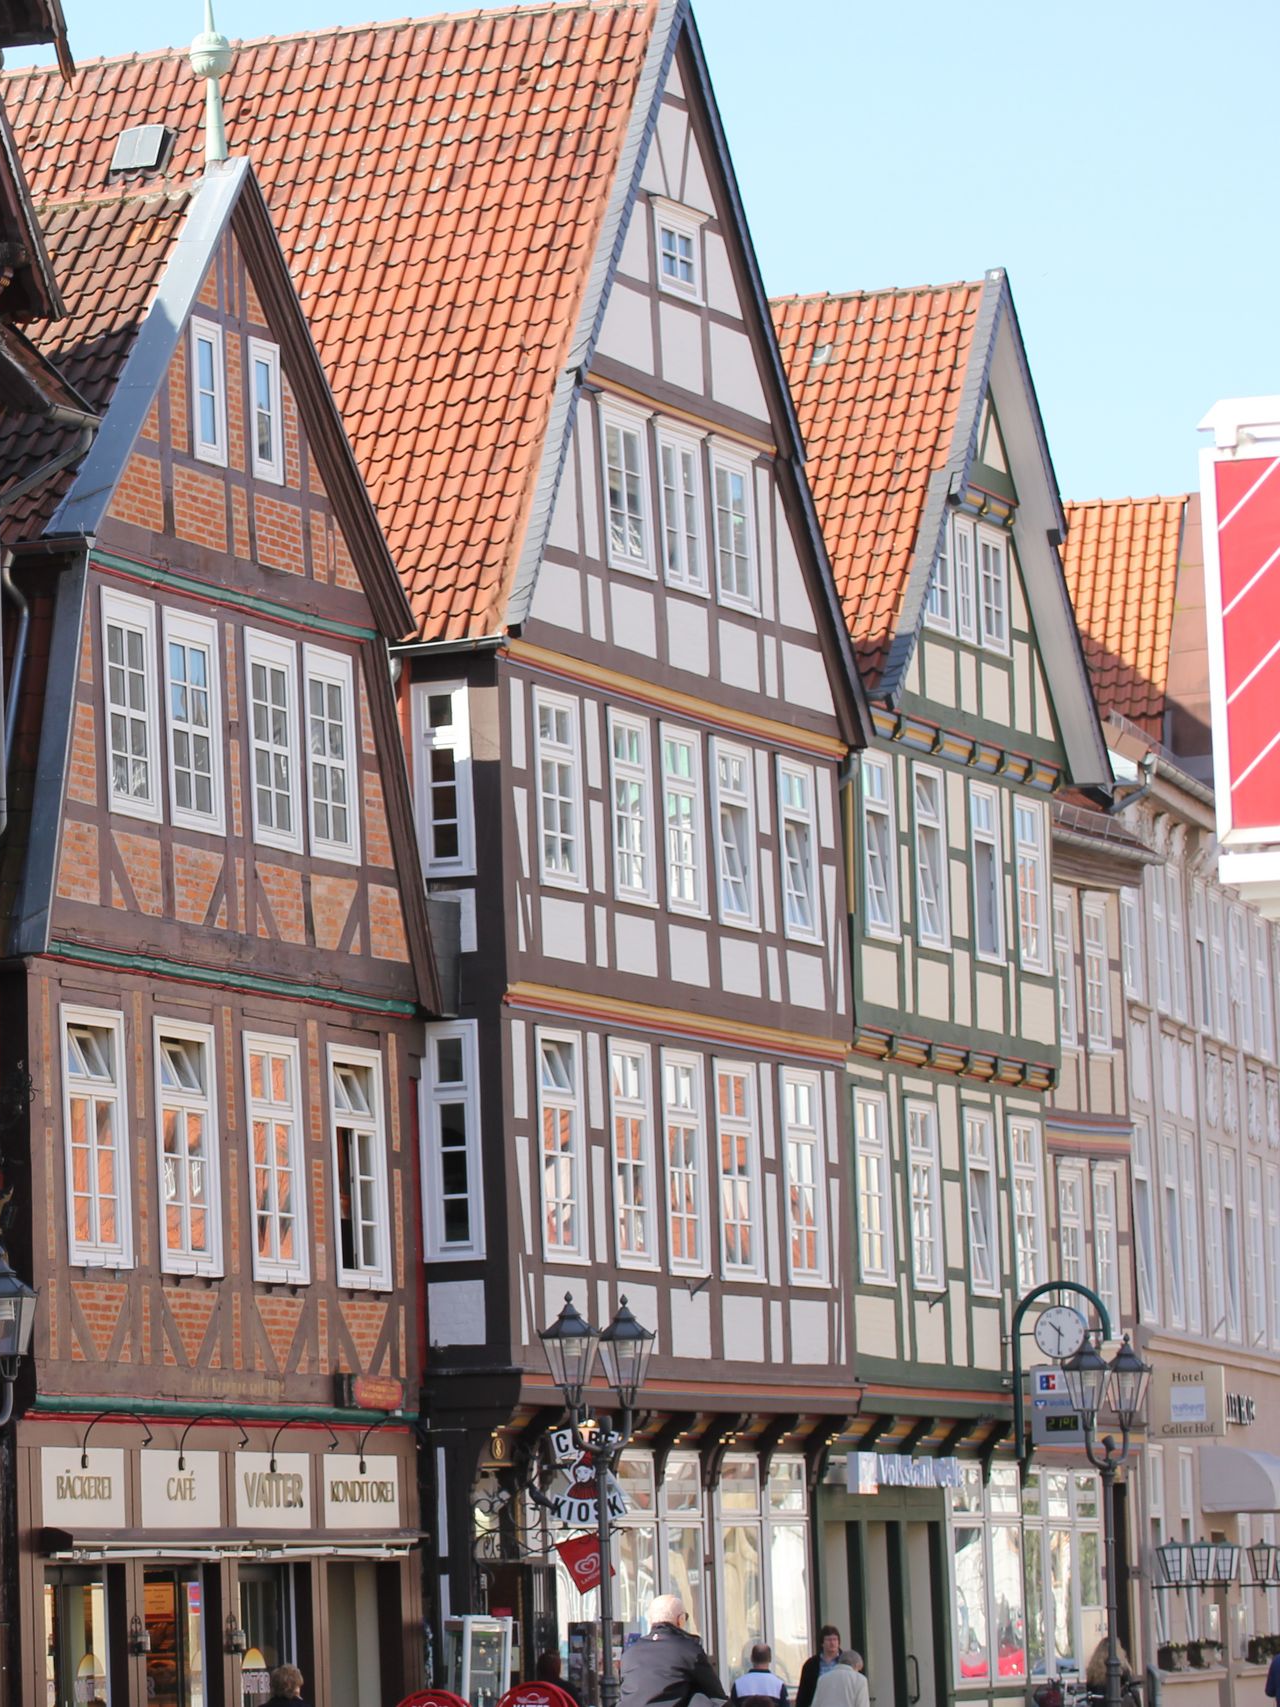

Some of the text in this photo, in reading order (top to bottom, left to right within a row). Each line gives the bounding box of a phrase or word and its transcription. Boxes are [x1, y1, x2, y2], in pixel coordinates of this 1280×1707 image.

[1171, 1370, 1204, 1382] Hotel
[1195, 1422, 1215, 1433] Hof
[56, 1469, 112, 1500] BÄCKEREI
[167, 1470, 197, 1501] CAFÉ
[244, 1472, 303, 1508] VATTER
[330, 1480, 394, 1503] KONDITOREI
[551, 1495, 623, 1522] KIOSK
